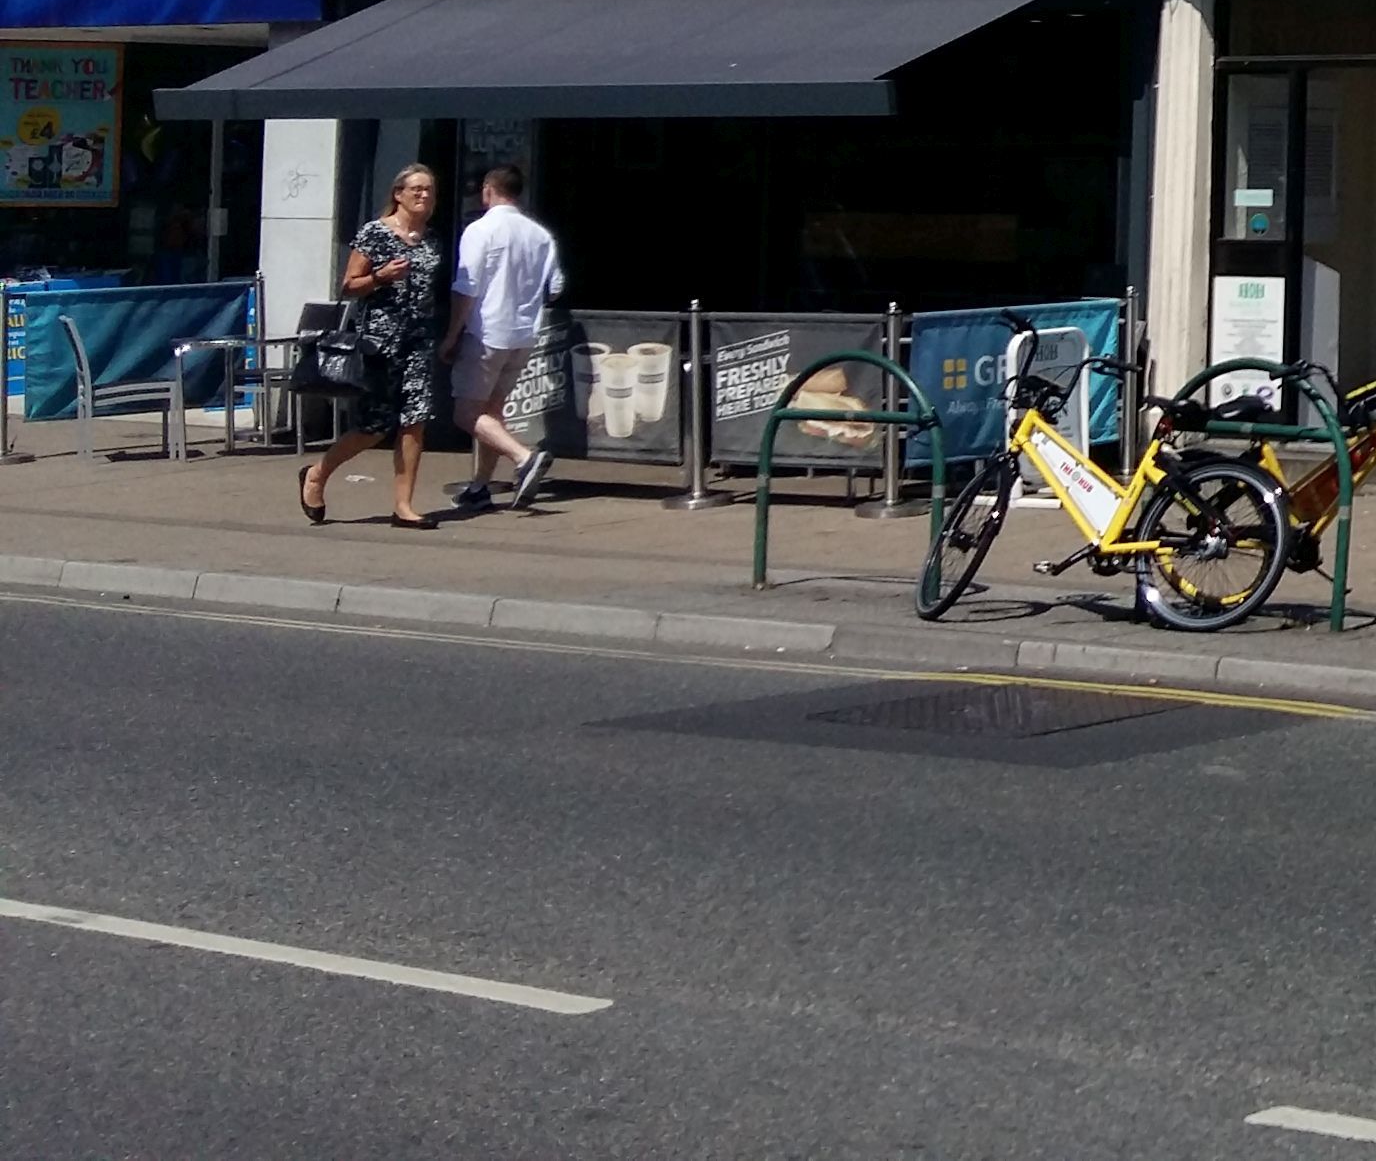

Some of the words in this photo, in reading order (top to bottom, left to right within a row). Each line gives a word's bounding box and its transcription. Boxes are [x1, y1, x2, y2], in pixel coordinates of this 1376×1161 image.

[71, 56, 109, 76] YOU
[9, 77, 108, 101] TEACHER
[716, 352, 790, 389] FRESHLY
